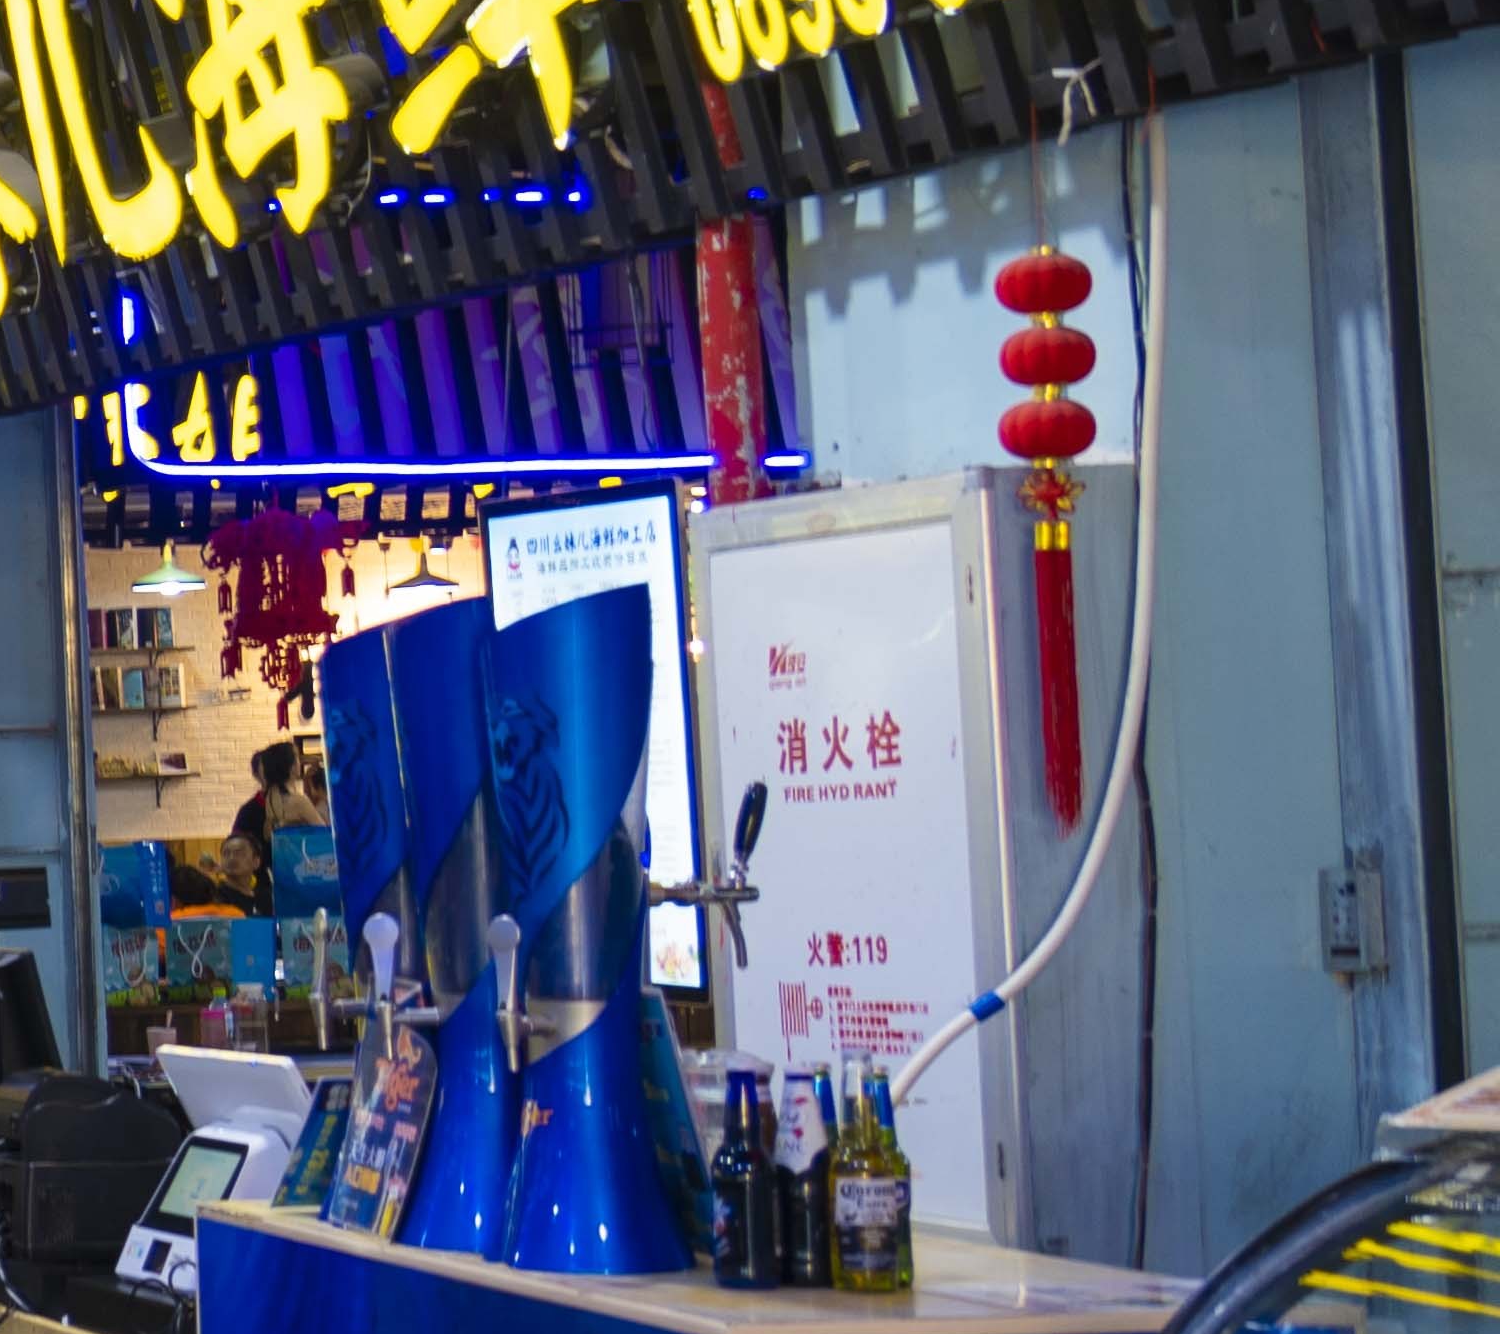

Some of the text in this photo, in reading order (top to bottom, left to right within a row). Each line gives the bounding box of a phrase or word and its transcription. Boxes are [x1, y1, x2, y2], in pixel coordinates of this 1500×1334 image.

[777, 710, 902, 775] 消火栓
[784, 785, 814, 803] FIRE
[807, 932, 888, 967] 火警:119
